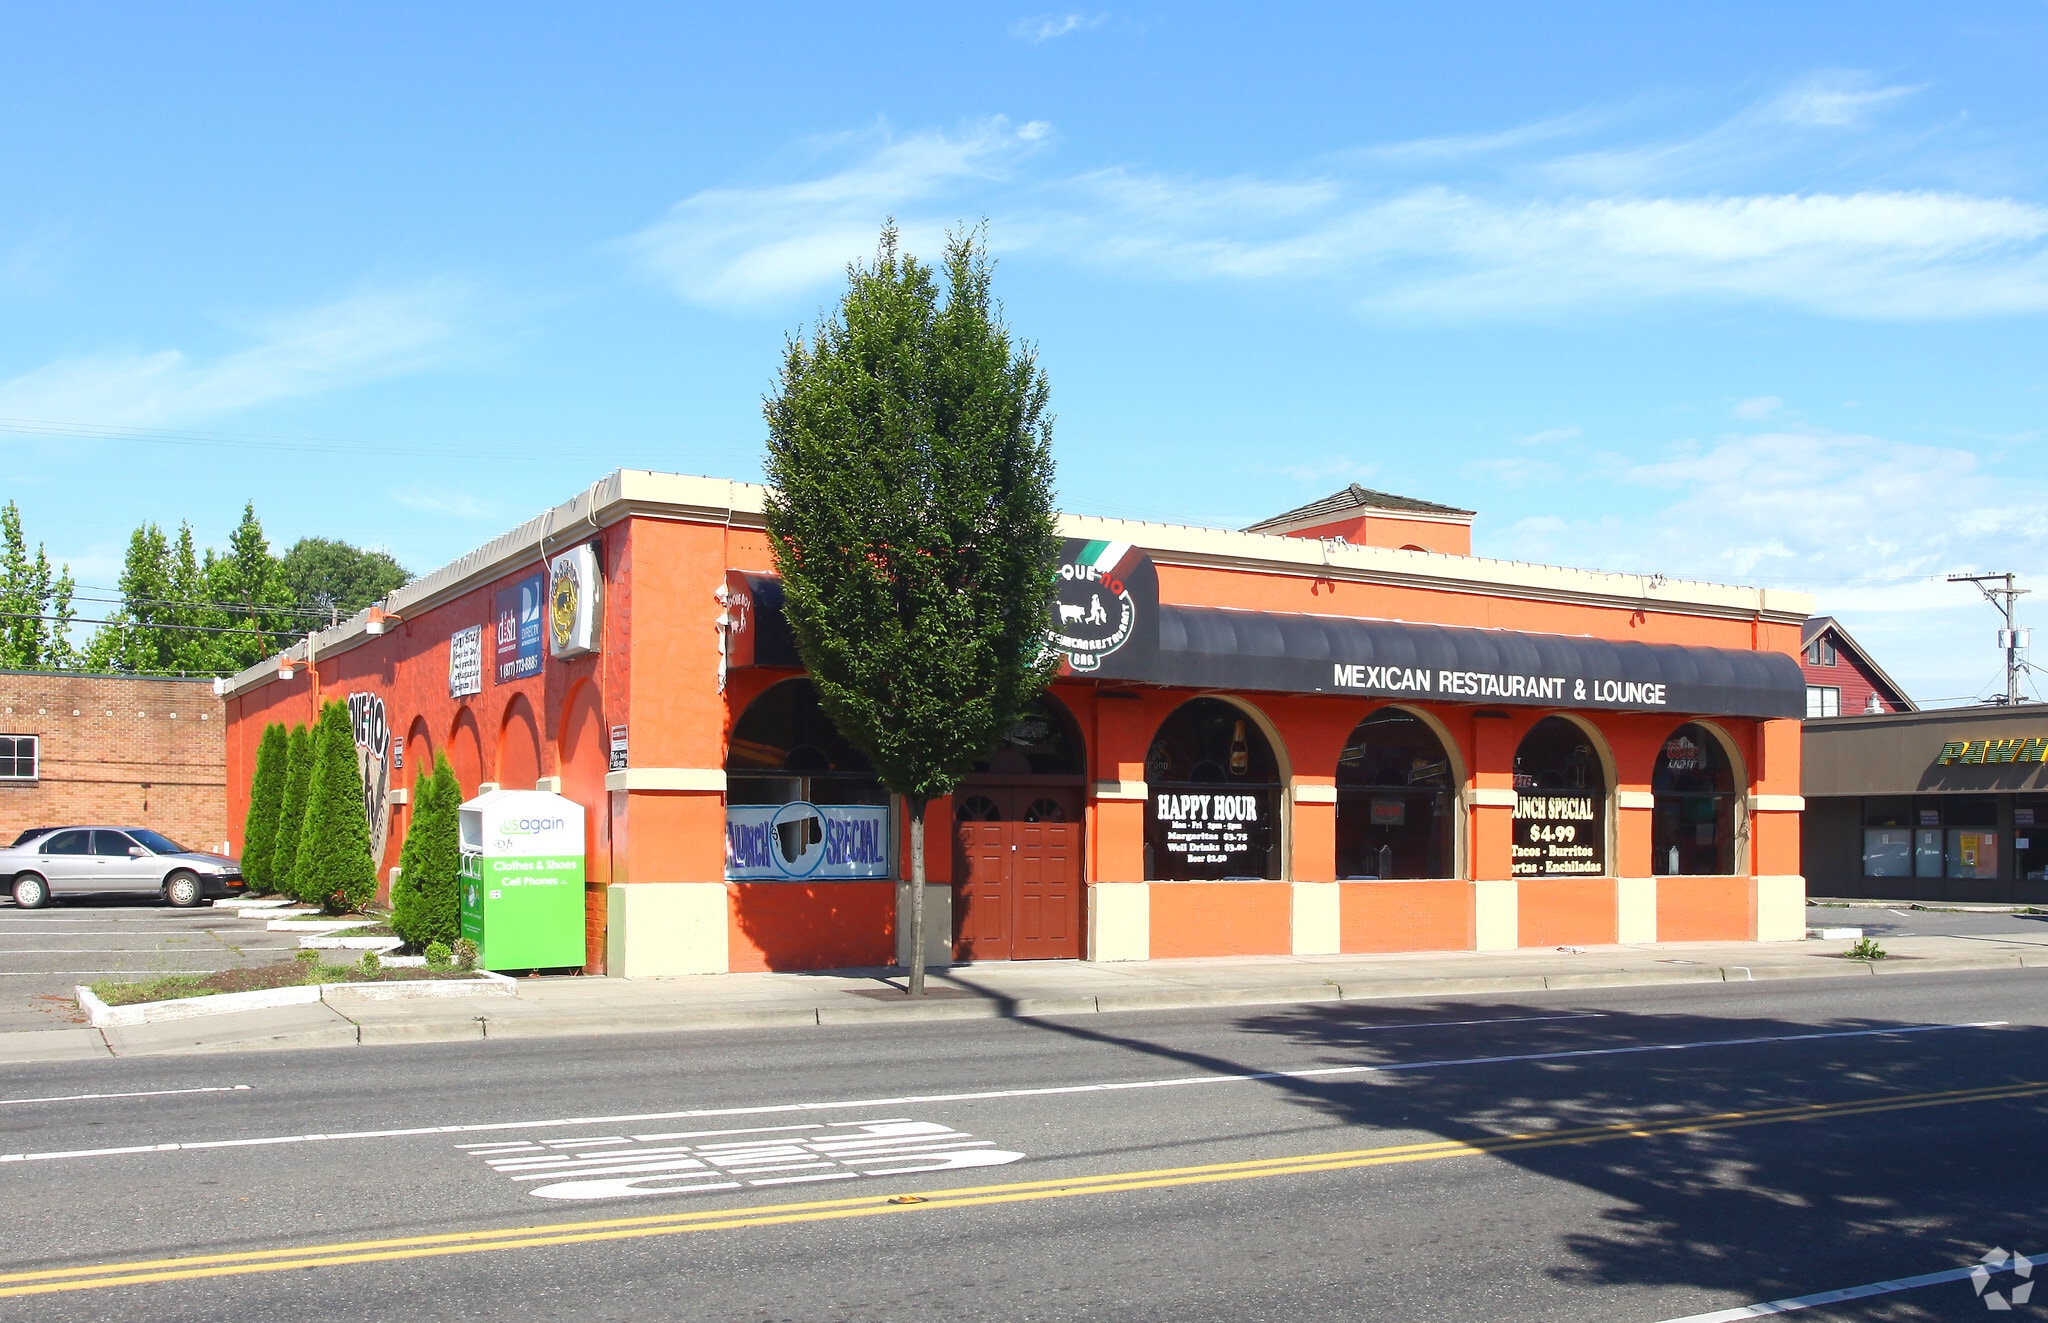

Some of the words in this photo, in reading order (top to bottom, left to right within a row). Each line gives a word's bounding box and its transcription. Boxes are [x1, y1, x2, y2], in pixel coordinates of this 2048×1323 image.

[1061, 564, 1096, 581] QUE
[498, 609, 517, 646] dish
[521, 623, 540, 640] DIRECTV
[1073, 652, 1095, 666] BAR
[1333, 663, 1431, 691] MEXICAN
[1438, 671, 1566, 699] RESTAURANT
[1573, 678, 1587, 701] &
[1594, 680, 1667, 705] LOUNGE
[1157, 794, 1211, 820] HAPPY
[1213, 795, 1258, 821] HOUR
[1548, 797, 1594, 820] SPECIAL
[502, 816, 564, 834] usagain
[1530, 824, 1576, 842] $4.99
[728, 820, 771, 868] LUNCH
[826, 817, 884, 865] SPECIAL
[1167, 832, 1219, 841] Margaritas
[1223, 832, 1248, 841] $3.75
[1166, 843, 1187, 852] Well
[1189, 843, 1221, 852] Drinks
[1224, 843, 1248, 852] $3.00
[1511, 845, 1541, 857] Tacos
[1548, 844, 1594, 857] Burritos
[493, 861, 534, 871] Clothes
[536, 861, 544, 870] &
[546, 860, 577, 870] Shoes
[1187, 854, 1205, 863] Beer
[1545, 860, 1602, 874] Enchiladas
[501, 877, 521, 887] Cell
[524, 876, 559, 886] Phones
